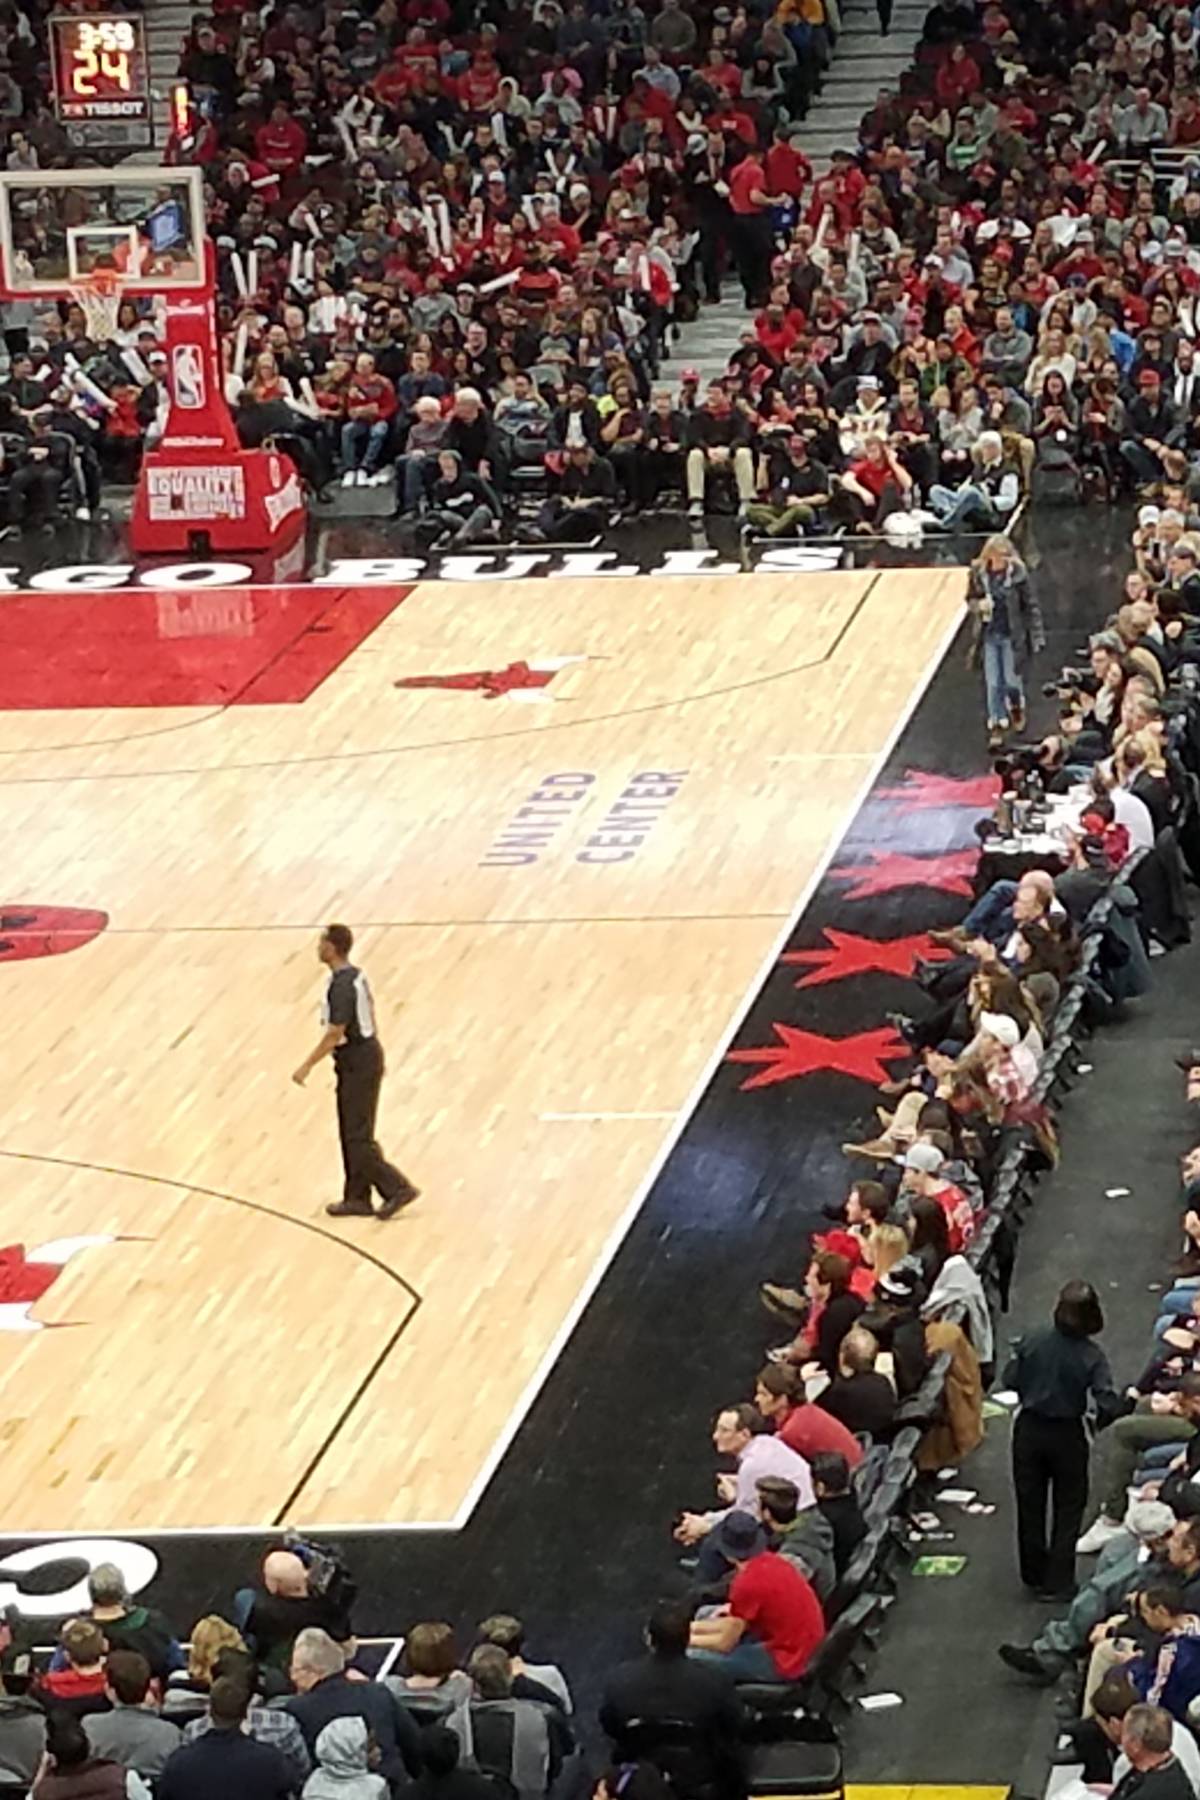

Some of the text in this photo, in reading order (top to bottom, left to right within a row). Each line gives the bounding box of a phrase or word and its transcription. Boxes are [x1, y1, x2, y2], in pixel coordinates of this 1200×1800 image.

[73, 50, 130, 95] 24
[313, 547, 843, 584] BULLS
[478, 771, 596, 867] UNITED
[576, 769, 690, 863] CENTER
